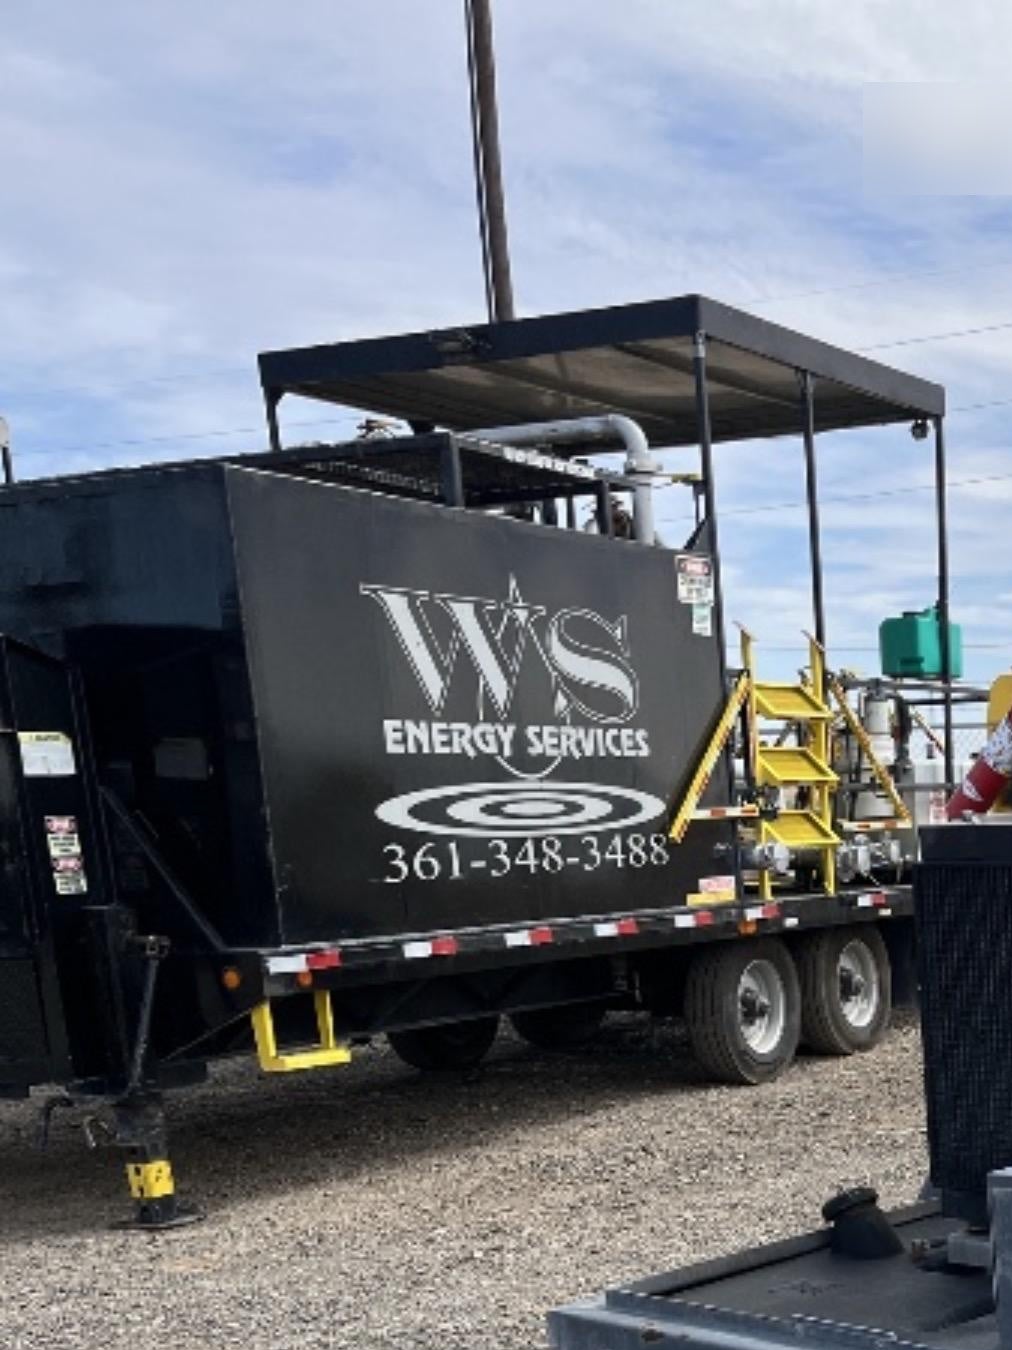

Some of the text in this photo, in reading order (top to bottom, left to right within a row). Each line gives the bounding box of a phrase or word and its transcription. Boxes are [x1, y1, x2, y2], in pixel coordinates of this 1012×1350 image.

[359, 580, 640, 724] WS
[382, 718, 651, 760] ENERGY SERVICES
[381, 832, 670, 884] 361-348-3488
